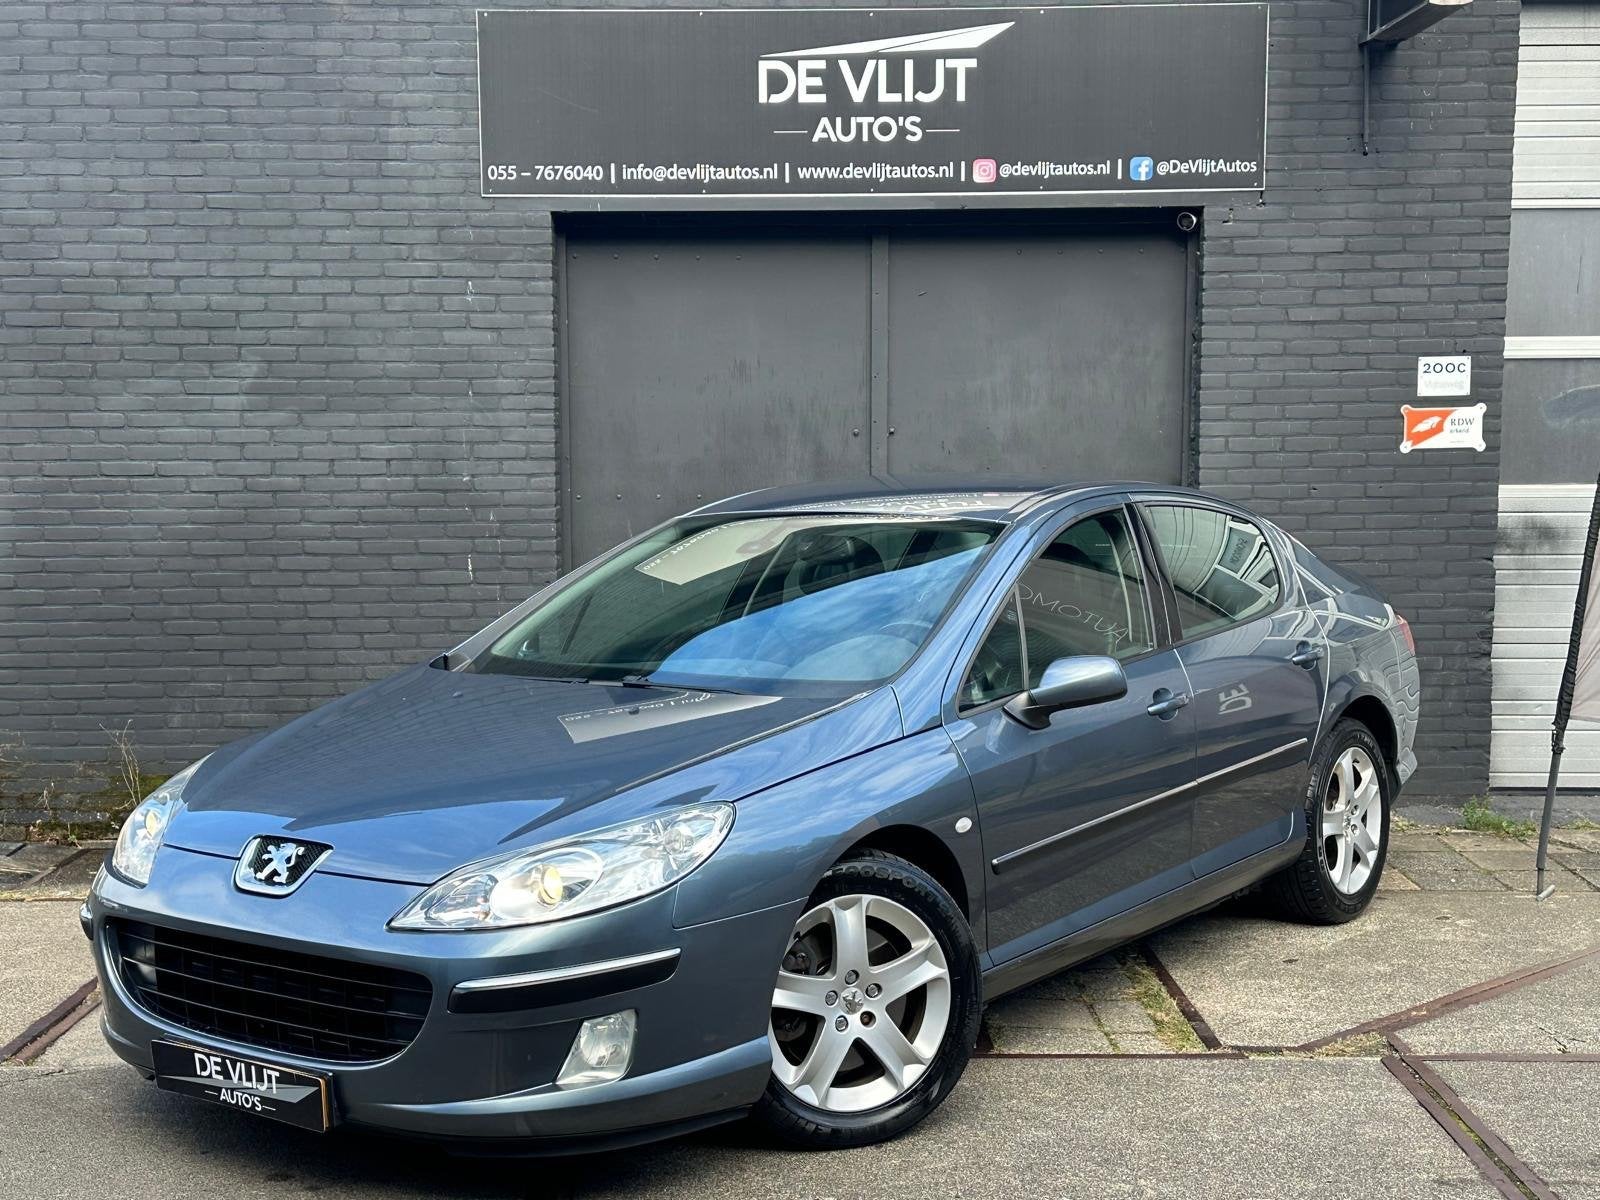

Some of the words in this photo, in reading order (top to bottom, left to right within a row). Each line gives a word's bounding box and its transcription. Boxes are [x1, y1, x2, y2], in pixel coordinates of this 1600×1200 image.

[757, 59, 827, 104] DE
[837, 57, 978, 103] VLIJT
[811, 115, 923, 143] AUTO'S
[487, 164, 517, 181] 055
[534, 165, 604, 181] 7676040
[622, 162, 778, 184] info@devlijtautos.nl
[797, 161, 954, 183] www.devlijtautos.nl
[999, 159, 1111, 179] @devlijtautos.nl
[1156, 158, 1258, 177] @DeVlijtAutos
[1423, 362, 1466, 374] 200C
[1450, 417, 1475, 426] RDW
[193, 1052, 224, 1081] DE
[225, 1059, 280, 1094] VLIJT
[219, 1087, 262, 1112] AUTO'S
